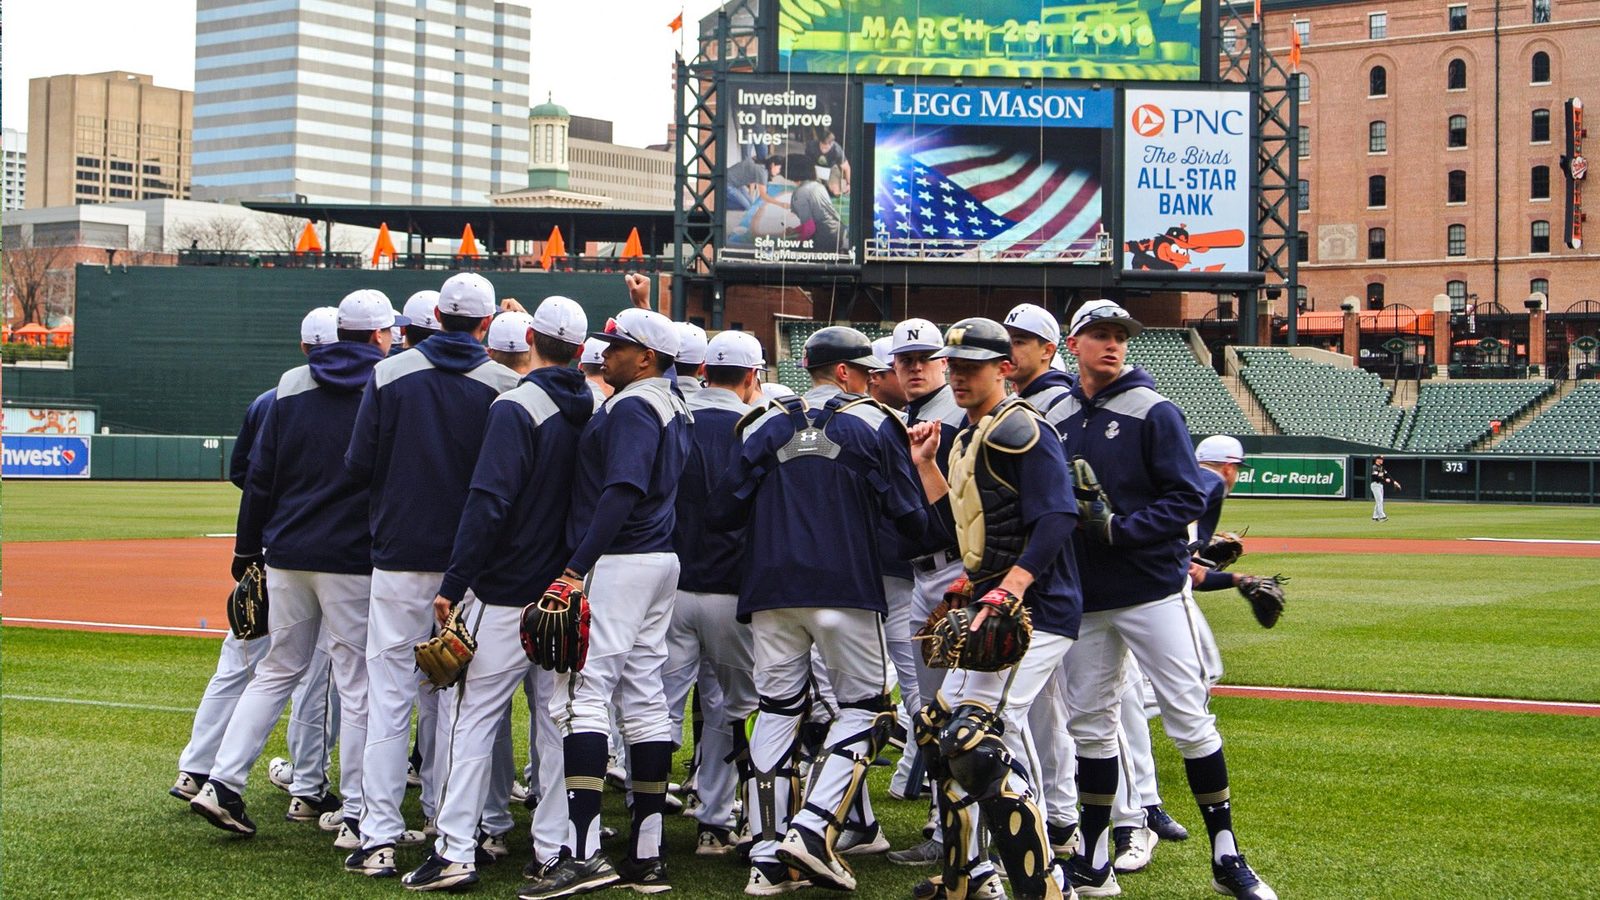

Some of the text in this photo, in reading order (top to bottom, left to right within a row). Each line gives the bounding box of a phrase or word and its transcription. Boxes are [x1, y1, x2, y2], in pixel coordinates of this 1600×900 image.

[861, 16, 984, 41] MARCH
[1003, 19, 1054, 48] 25,
[738, 89, 817, 110] Investing
[892, 88, 1085, 119] LEGG MASON
[737, 109, 832, 129] to Improve
[1171, 109, 1244, 136] PNC
[1143, 145, 1232, 165] The Birds
[1137, 167, 1237, 191] ALL-STAR
[1159, 193, 1214, 216] BANK
[777, 237, 801, 249] how
[802, 239, 814, 249] at
[1006, 312, 1019, 324] N
[907, 329, 920, 341] N
[203, 439, 219, 449] 410
[1445, 462, 1463, 473] 373
[1261, 471, 1287, 484] Car
[1289, 472, 1334, 485] Rental
